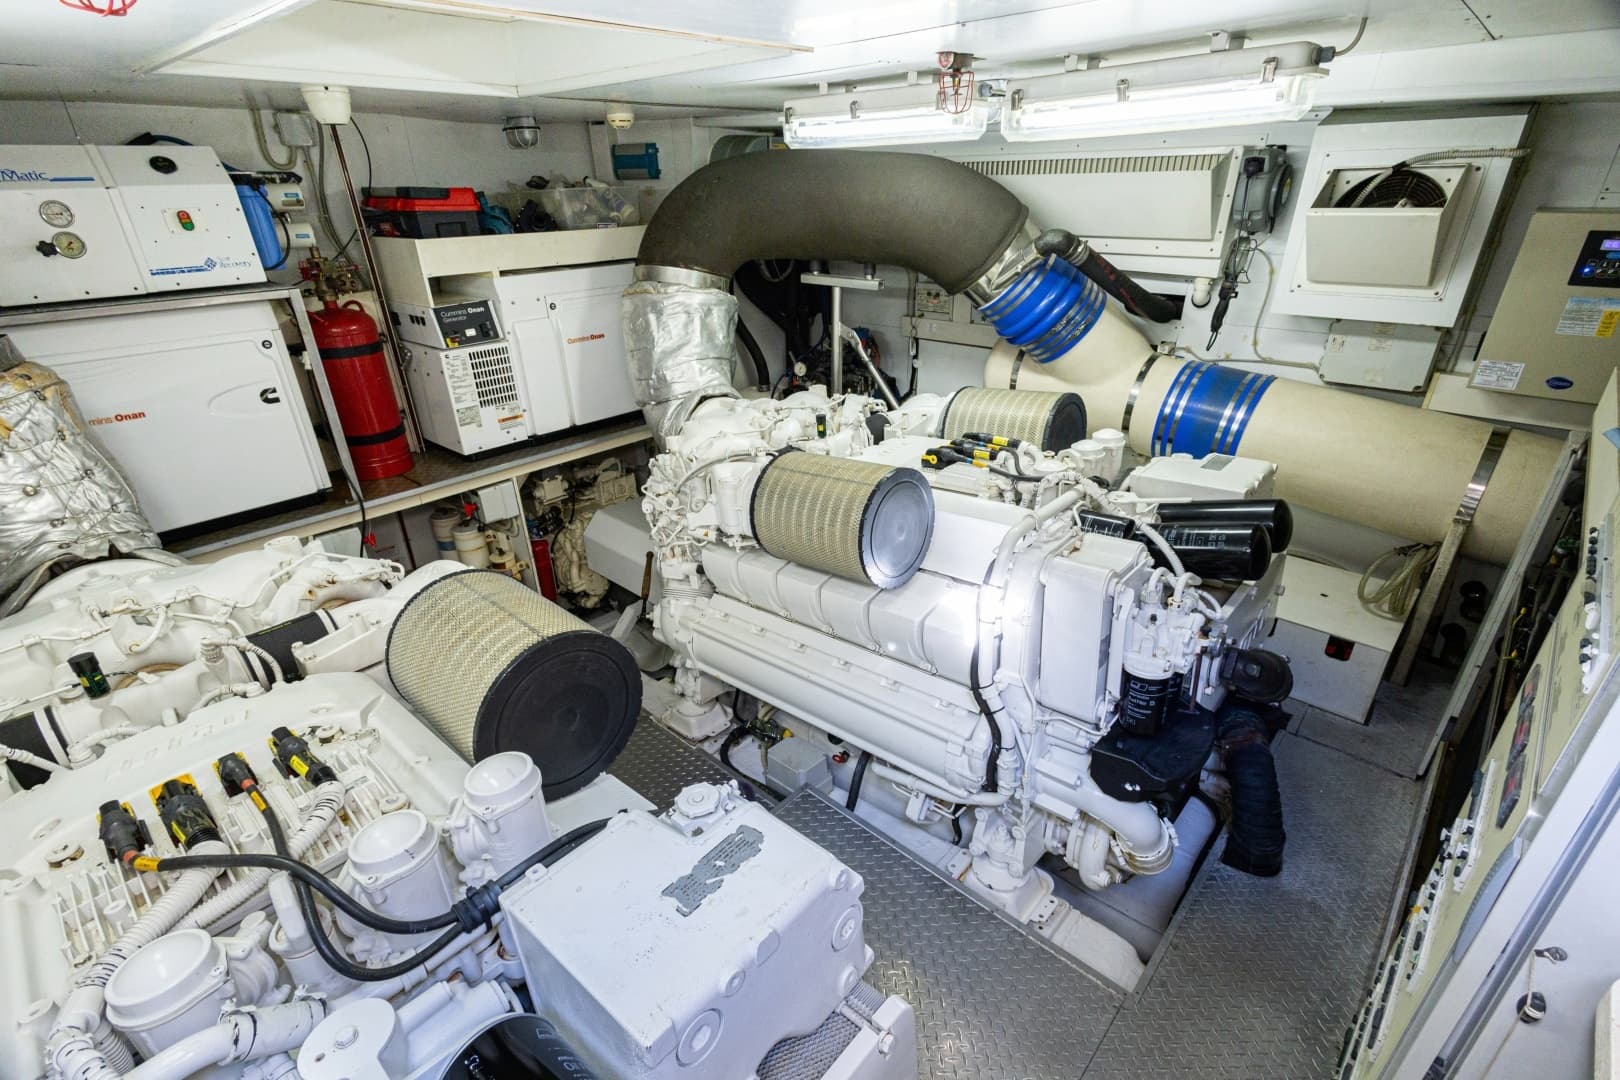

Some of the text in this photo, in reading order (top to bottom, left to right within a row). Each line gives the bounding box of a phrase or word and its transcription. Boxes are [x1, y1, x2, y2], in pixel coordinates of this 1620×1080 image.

[440, 309, 467, 318] Cummins
[443, 315, 467, 323] Generator
[567, 336, 590, 344] Cummins
[114, 411, 146, 422] Onan
